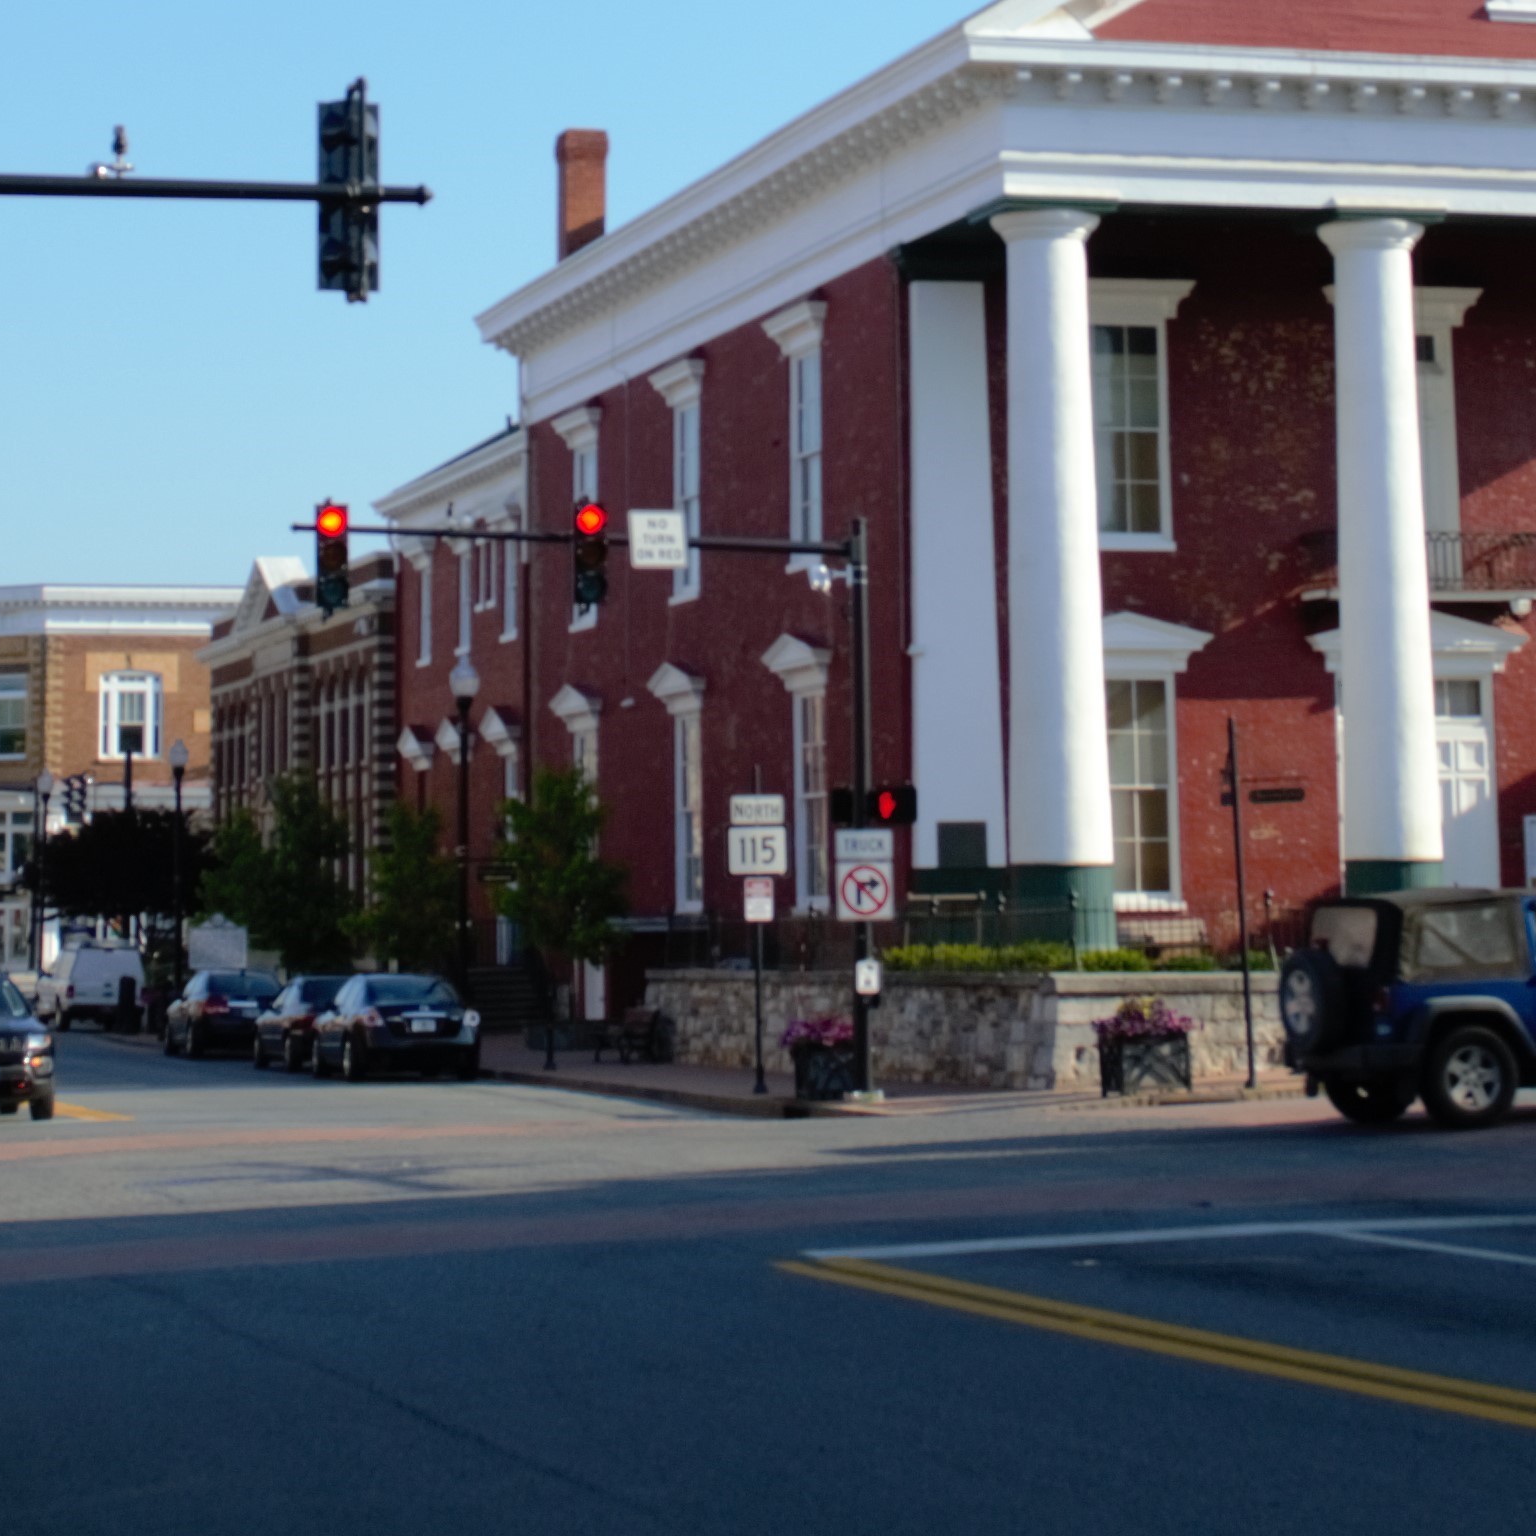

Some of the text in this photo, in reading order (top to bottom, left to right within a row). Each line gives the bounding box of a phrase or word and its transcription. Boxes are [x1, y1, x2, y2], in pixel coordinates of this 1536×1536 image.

[647, 518, 668, 529] NO
[643, 533, 675, 545] TURN
[637, 548, 681, 560] ON RED
[734, 803, 780, 818] NORTH
[739, 836, 777, 866] 115
[844, 837, 884, 852] TRUCK
